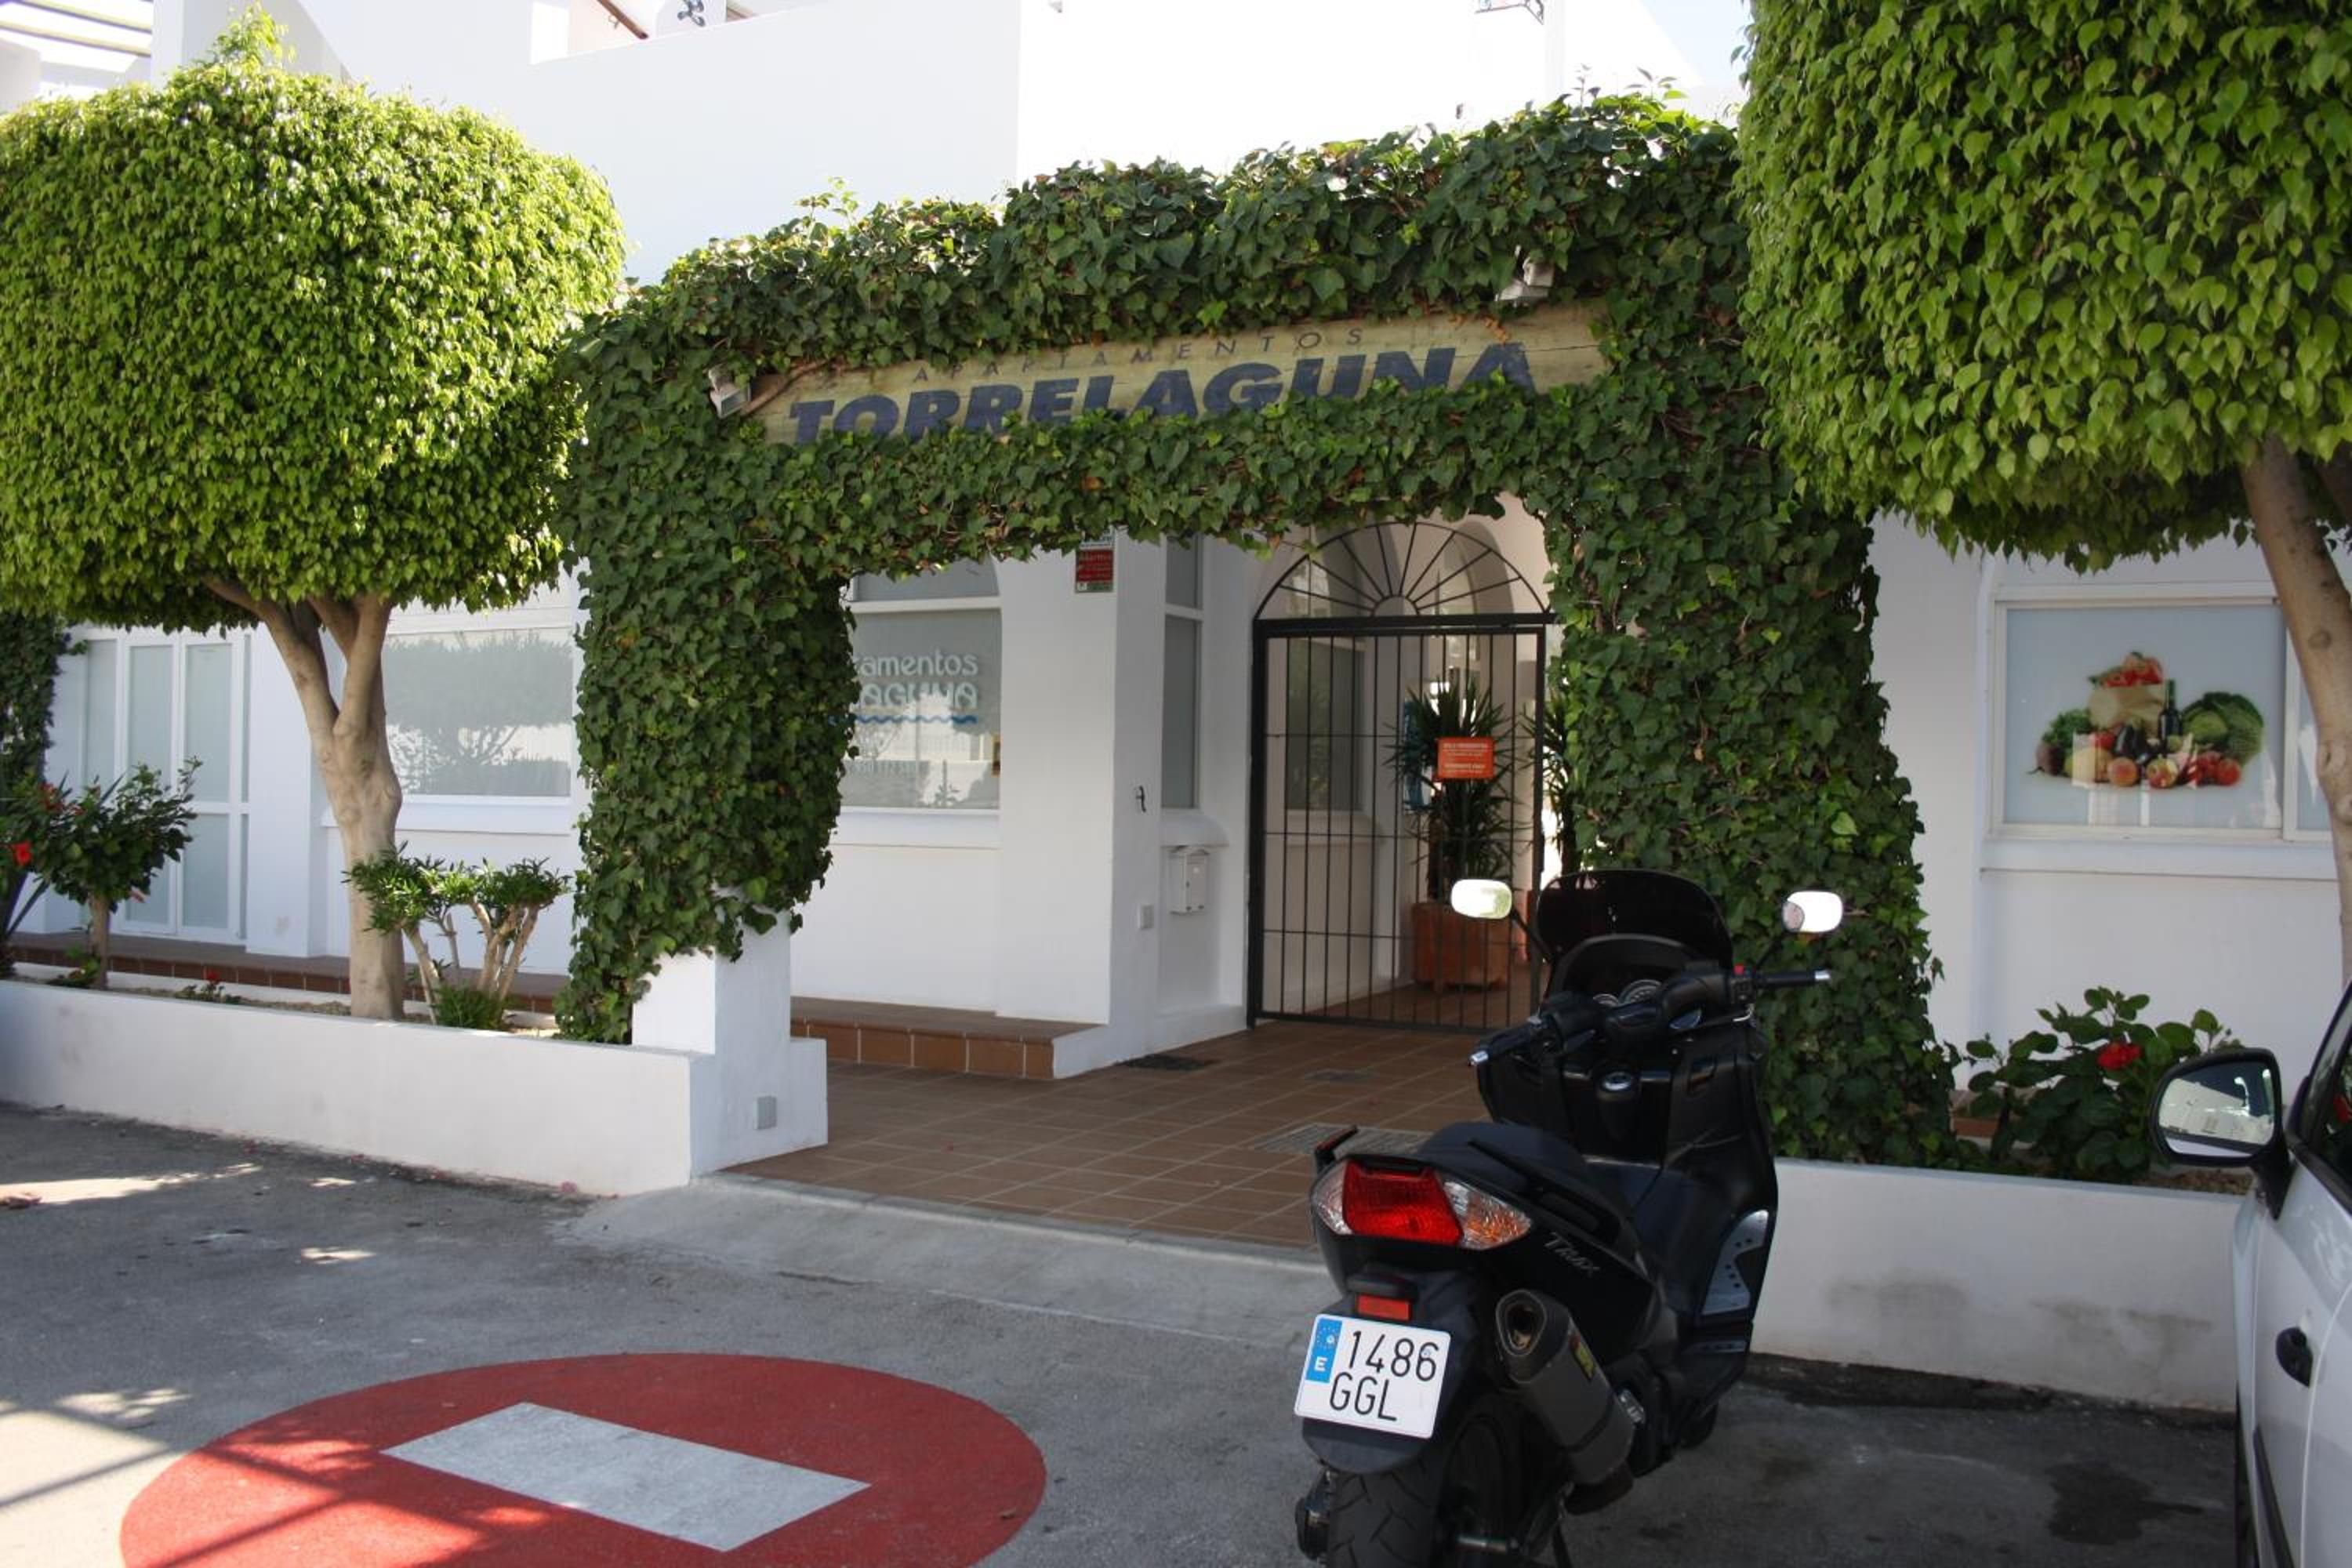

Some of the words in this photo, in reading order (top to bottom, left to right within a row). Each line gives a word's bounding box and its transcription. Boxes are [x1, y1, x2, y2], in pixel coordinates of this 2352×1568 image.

[913, 327, 1363, 383] APARTAMENTOS
[789, 341, 1536, 445] TORRELAGUNA
[852, 648, 978, 677] amentos
[1314, 1356, 1328, 1371] E
[1348, 1330, 1439, 1382] 1486
[1329, 1371, 1397, 1422] GGL
